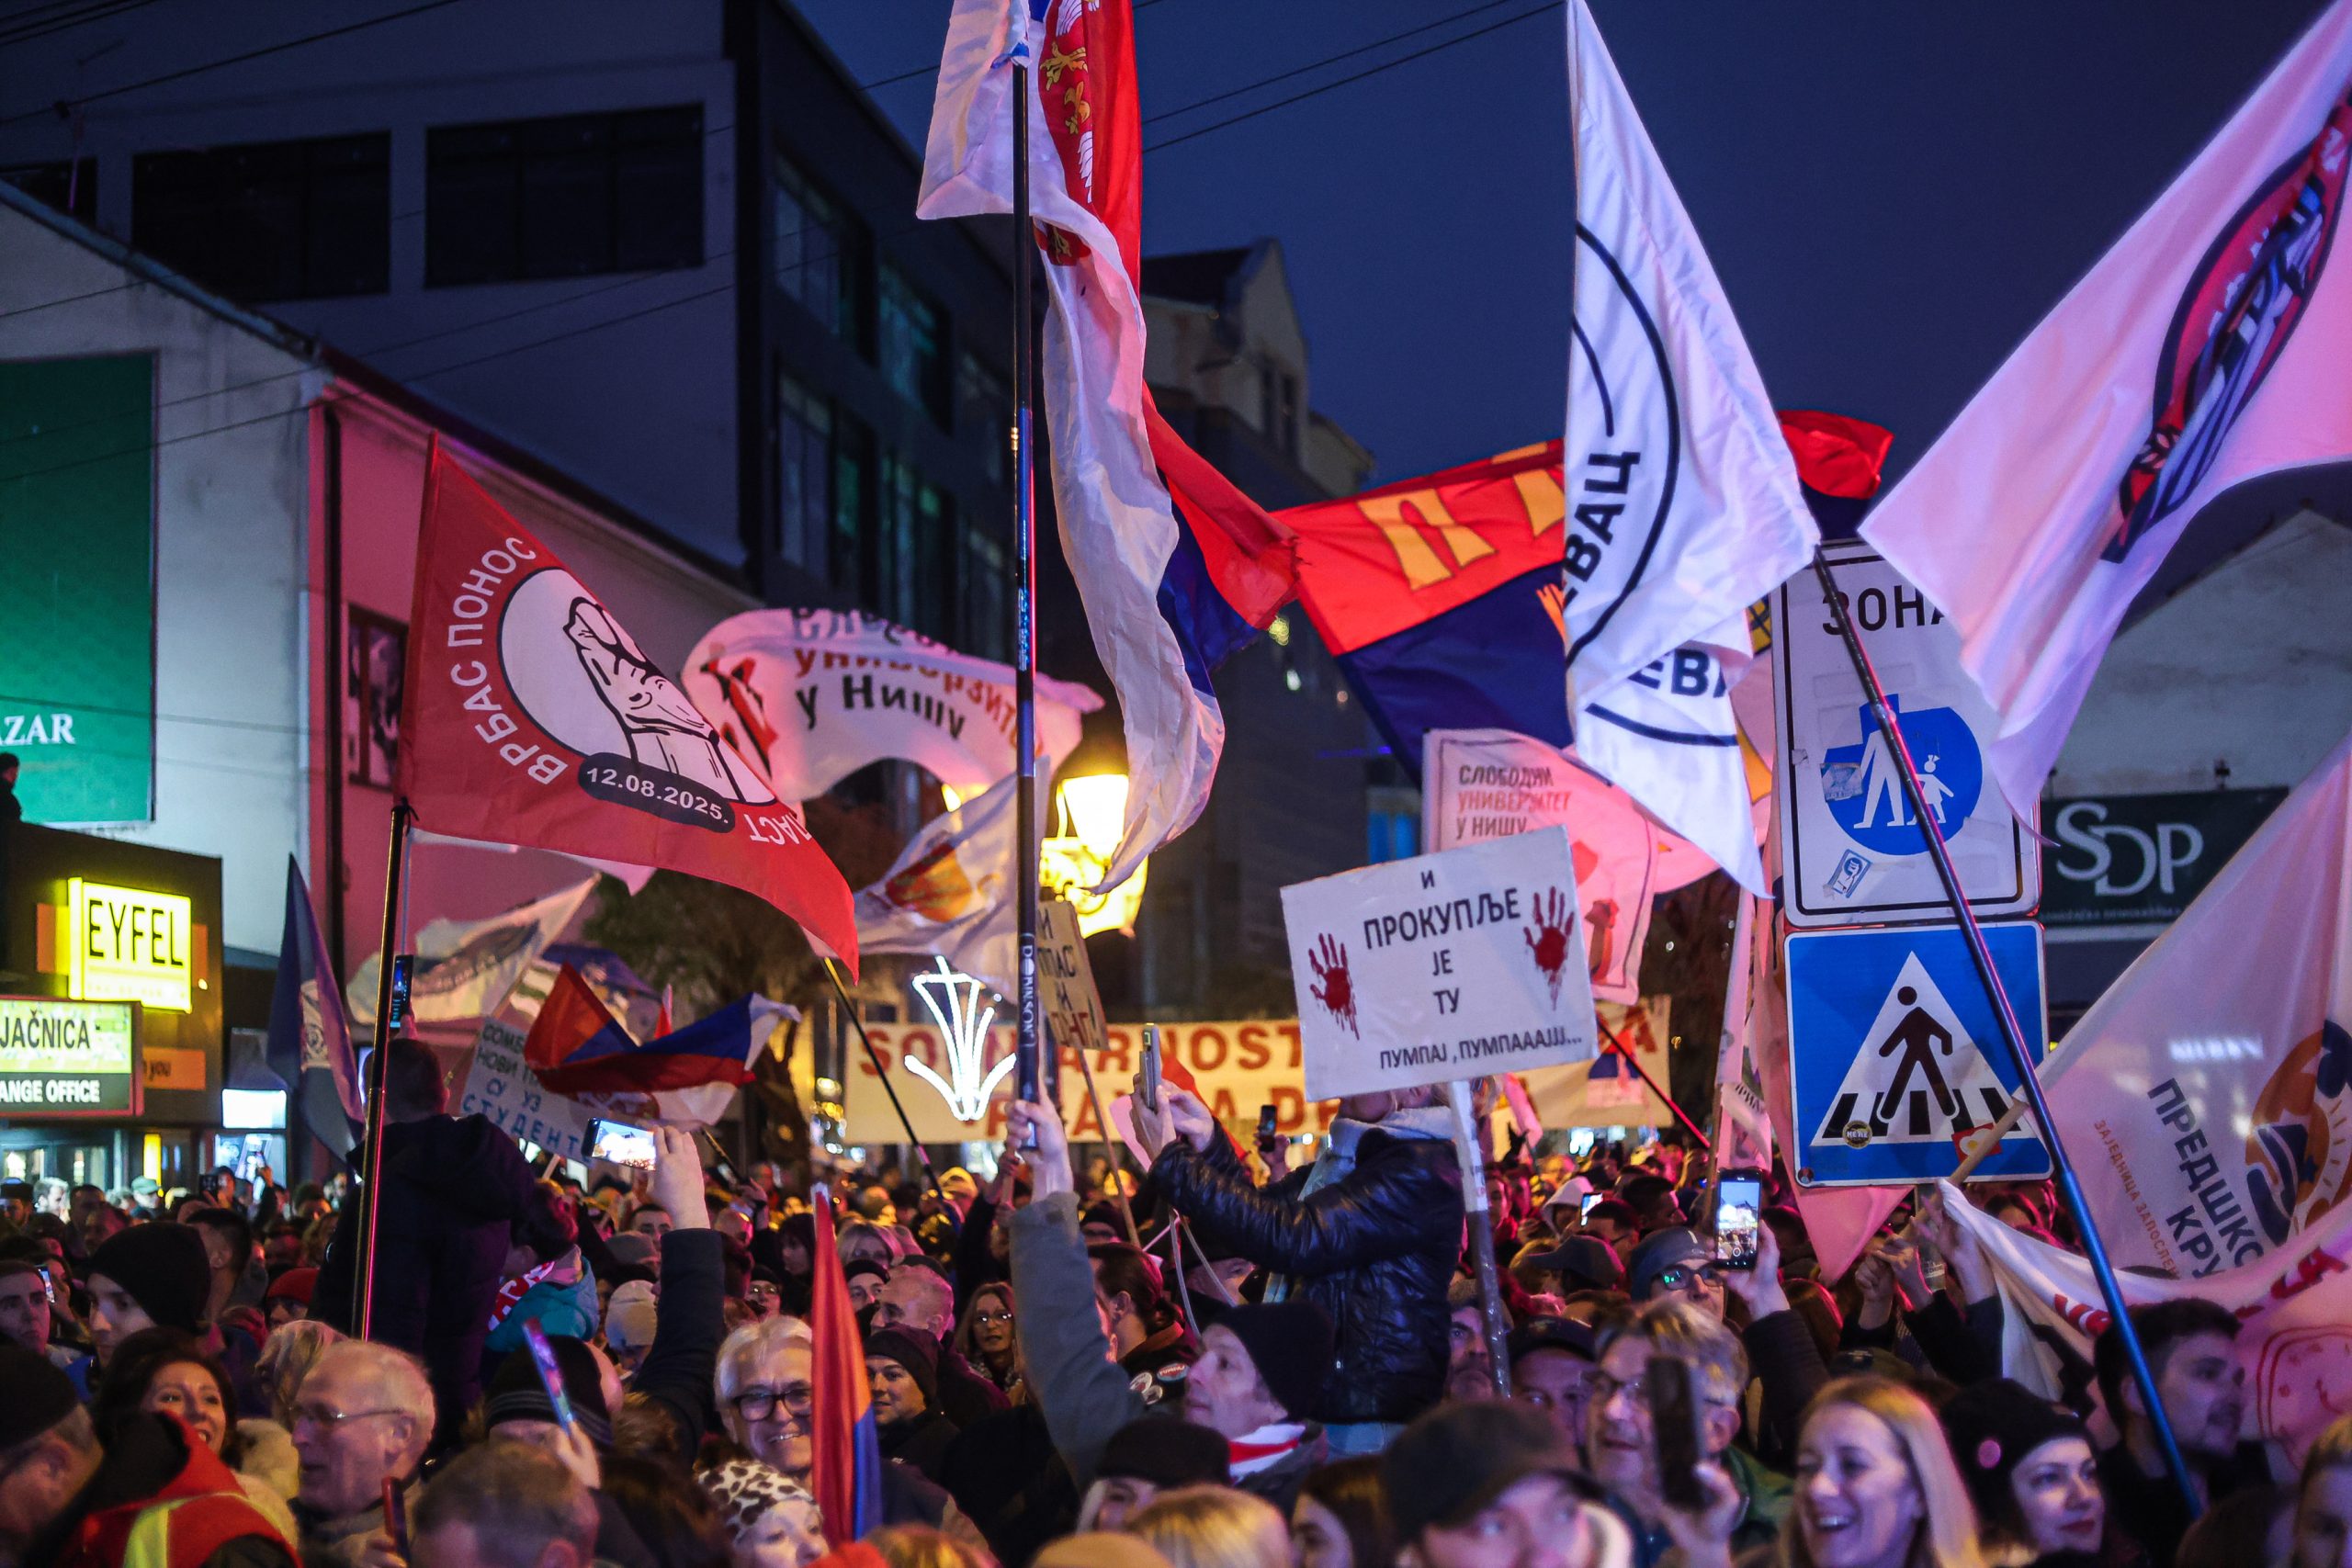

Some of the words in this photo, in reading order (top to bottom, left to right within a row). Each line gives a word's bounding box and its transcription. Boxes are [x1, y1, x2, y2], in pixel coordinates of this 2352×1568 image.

[1563, 451, 1641, 610] ВАЦ
[447, 536, 537, 647] ПОНОС
[1627, 648, 1728, 698] ЕВ
[0, 713, 76, 746] ZAR
[450, 660, 568, 784] ВРБАС
[842, 674, 966, 739] Нишу
[586, 767, 729, 824] 12.08.2025.
[1456, 817, 1467, 840] У
[1472, 816, 1528, 837] НИШУ
[2055, 801, 2204, 897] SDP
[1421, 870, 1435, 889] И
[89, 899, 184, 966] EYFEL
[1363, 887, 1521, 950] ПРОКУПЉЕ
[1432, 949, 1454, 976] ЈЕ
[1433, 987, 1460, 1015] ТУ
[0, 1009, 90, 1049] JAČNICA
[1380, 1043, 1447, 1070] ПУМПАЈ
[45, 1079, 101, 1103] OFFICE
[461, 1093, 594, 1164] СТУДЕНТ
